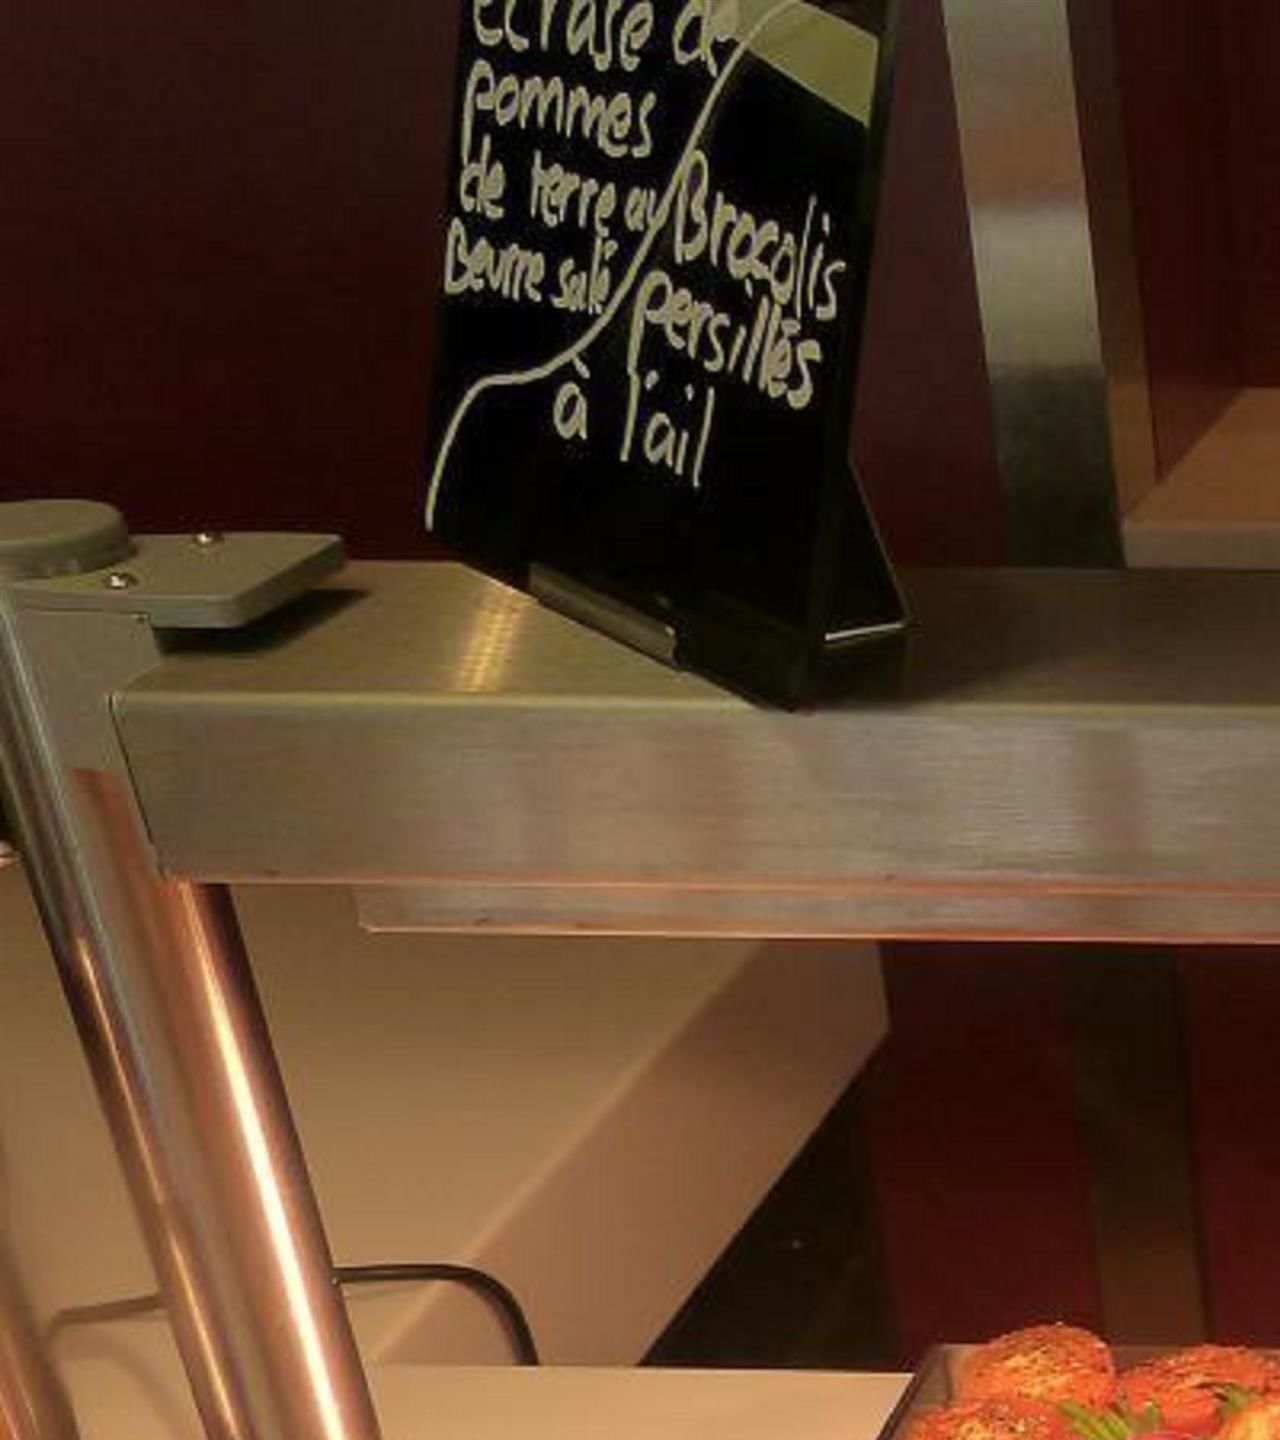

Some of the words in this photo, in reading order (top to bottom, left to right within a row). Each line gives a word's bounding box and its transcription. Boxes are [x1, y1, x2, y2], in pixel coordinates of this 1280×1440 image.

[459, 133, 506, 219] de
[531, 149, 618, 238] terre
[444, 216, 547, 302] Beurre
[674, 149, 848, 323] Brocolis
[552, 350, 590, 440] à
